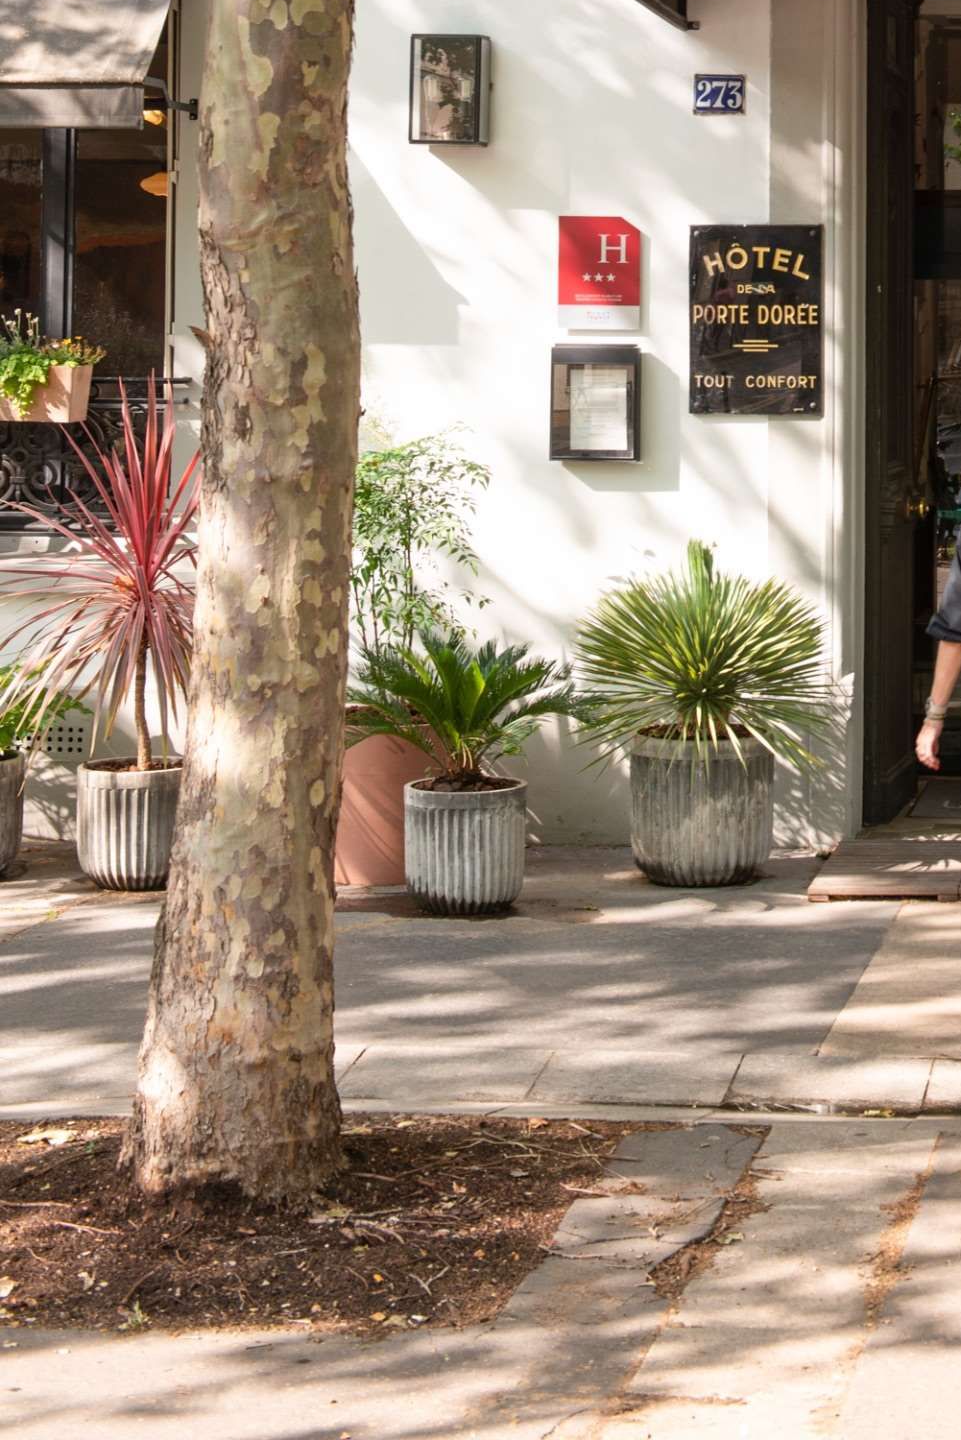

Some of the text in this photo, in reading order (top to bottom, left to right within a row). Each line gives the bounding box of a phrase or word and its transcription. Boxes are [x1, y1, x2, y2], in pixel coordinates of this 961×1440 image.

[696, 80, 742, 109] 273
[598, 233, 630, 263] H
[703, 242, 810, 281] HÔTEL
[736, 283, 752, 294] DE
[692, 303, 819, 325] PORTE DORÉE
[694, 374, 817, 388] TOUT CONFORT
